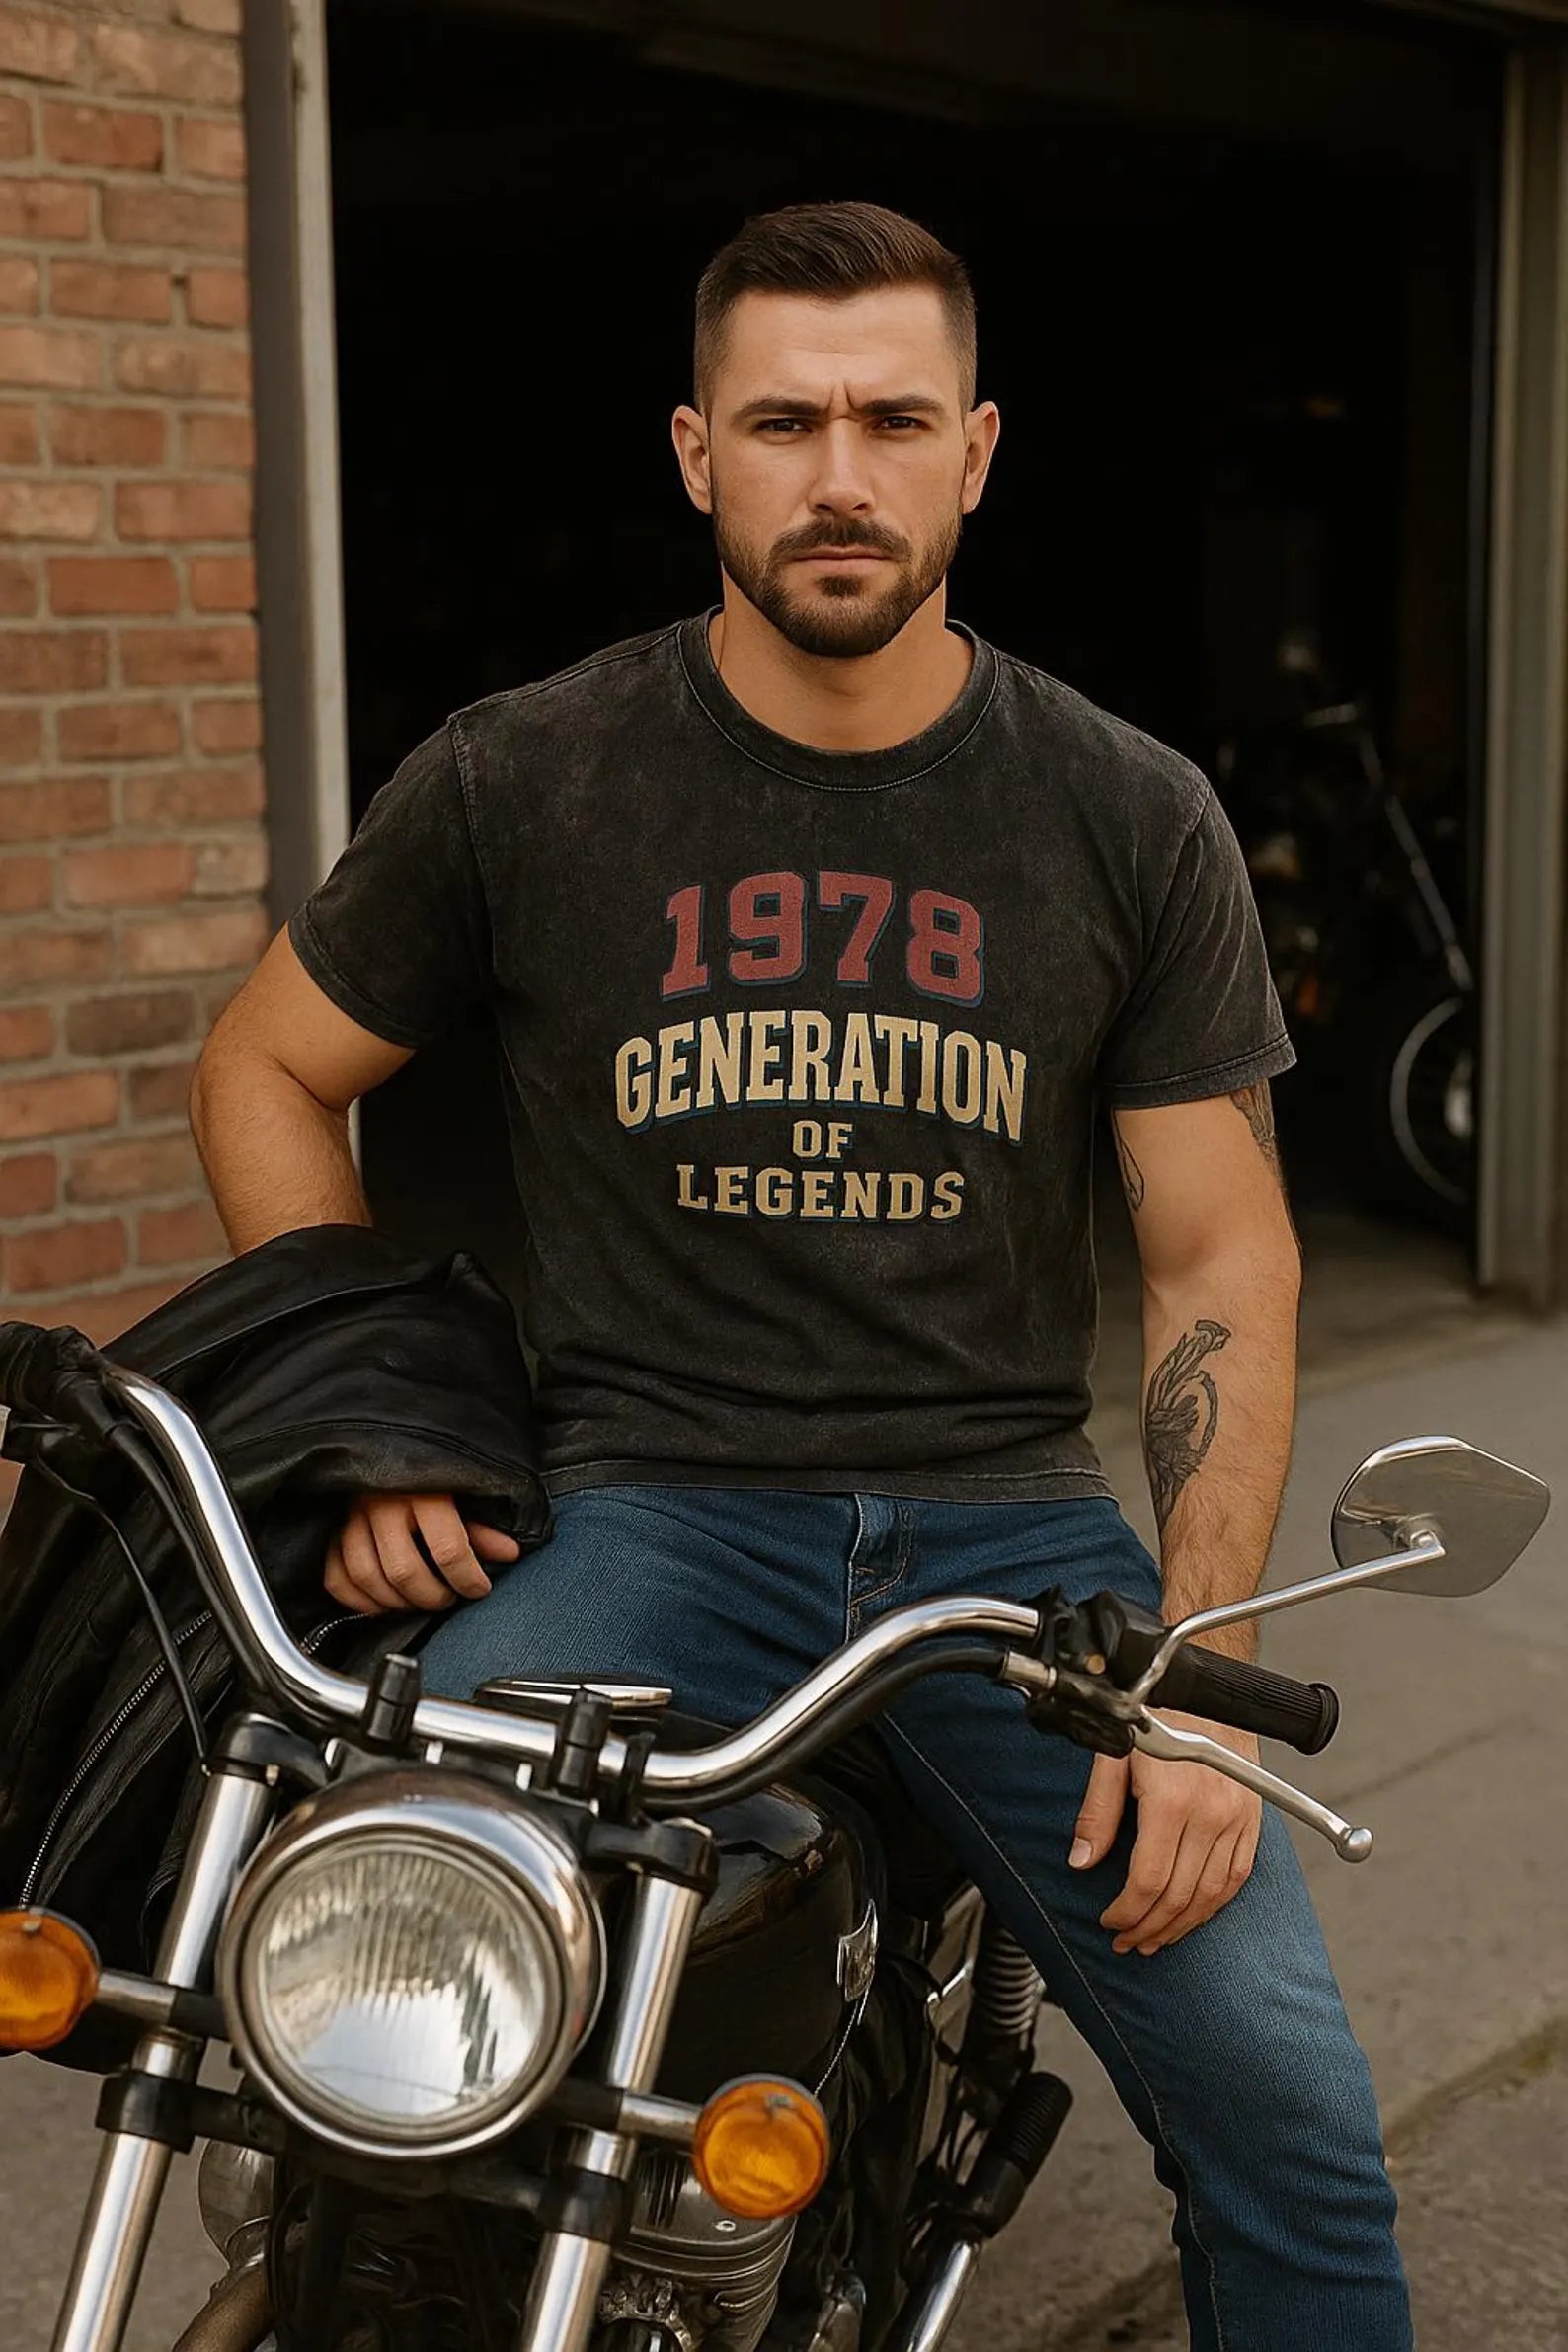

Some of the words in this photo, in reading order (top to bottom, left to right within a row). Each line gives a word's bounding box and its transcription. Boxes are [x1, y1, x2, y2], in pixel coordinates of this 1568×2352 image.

[661, 870, 984, 1007] 1978
[614, 1009, 1028, 1145] GENERATION
[792, 1119, 855, 1160] OF
[676, 1164, 967, 1223] LEGENDS
